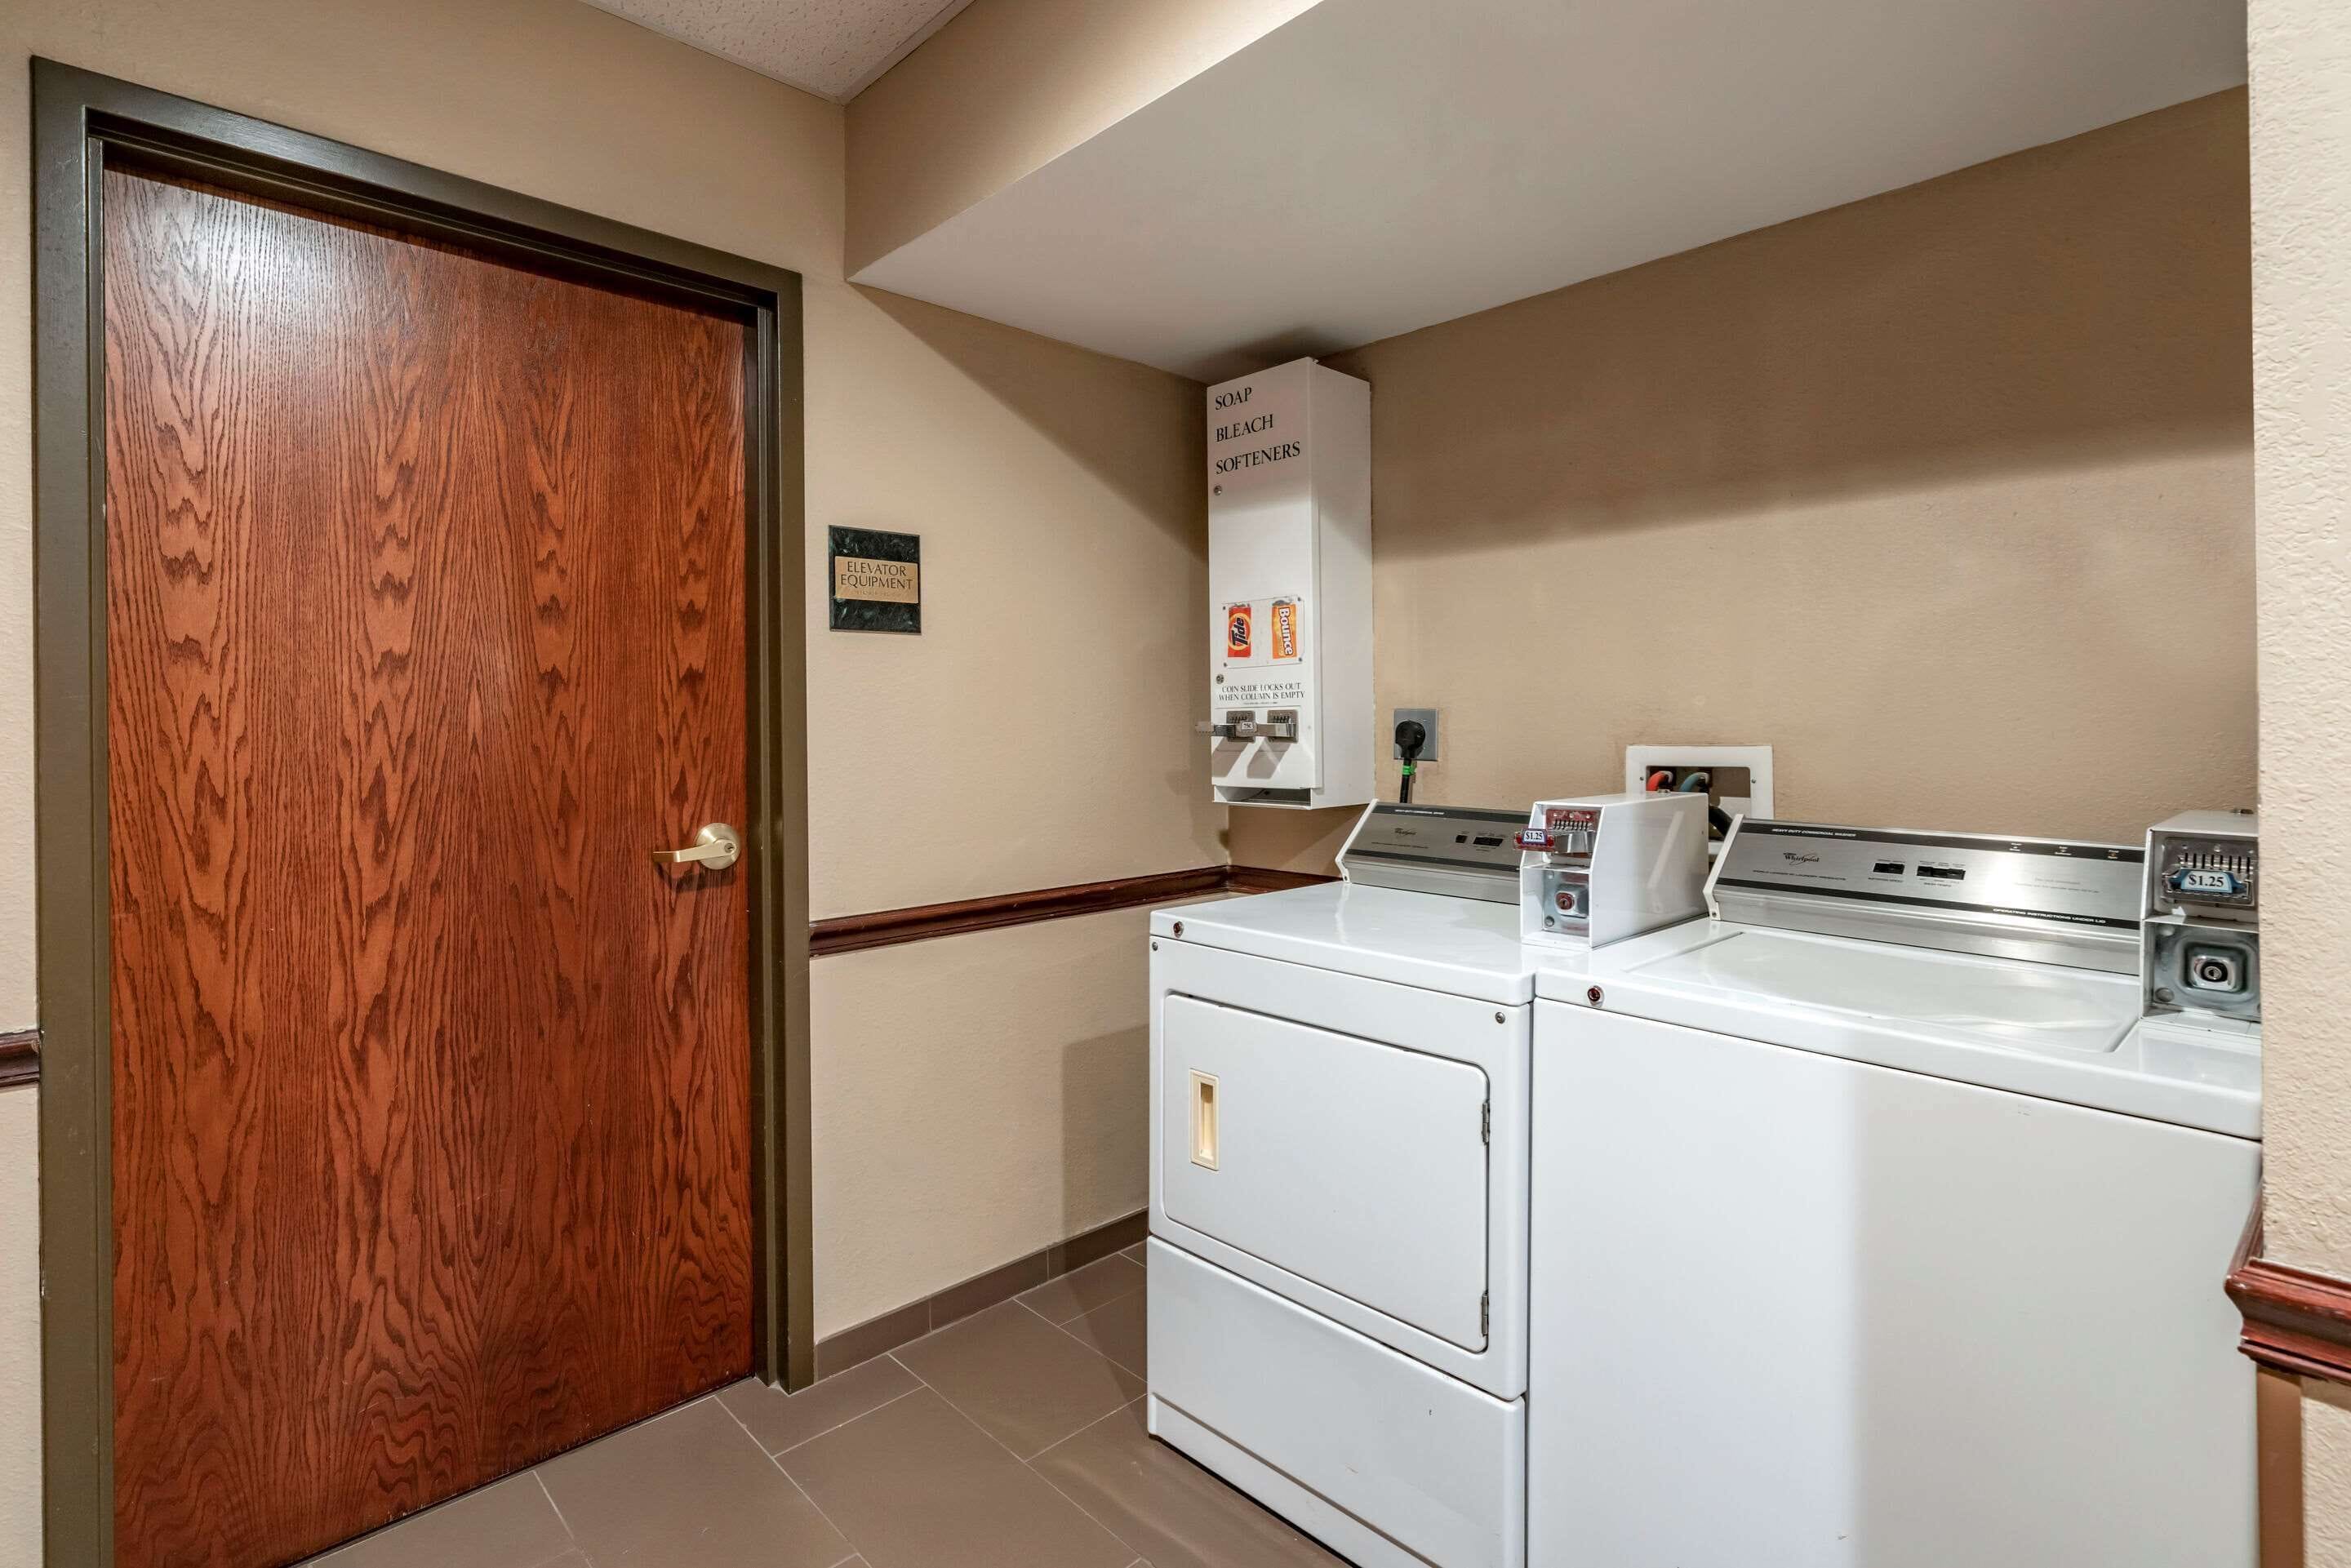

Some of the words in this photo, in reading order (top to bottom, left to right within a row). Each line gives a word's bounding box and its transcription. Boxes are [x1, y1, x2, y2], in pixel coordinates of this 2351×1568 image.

[1215, 387, 1252, 410] SOAP
[1216, 414, 1273, 442] BLEACH
[1215, 441, 1300, 474] SOFTENERS
[847, 561, 906, 576] ELEVATOR
[841, 574, 913, 589] EQUIPMENT
[1232, 617, 1248, 646] Tide
[1278, 606, 1293, 655] Bounce
[1222, 685, 1238, 693] COIN
[1240, 684, 1258, 692] SLIDE
[1260, 683, 1284, 691] LOCKS
[1285, 682, 1300, 691] OUT
[1219, 693, 1239, 701] WHEN
[1241, 692, 1270, 700] COLUMN
[1273, 691, 1278, 700] IS
[1281, 691, 1305, 700] EMPTY
[1784, 853, 1820, 864] Whirlpool
[2189, 874, 2224, 887] $1.25
[2027, 911, 2071, 920] INSTRUCTIONS
